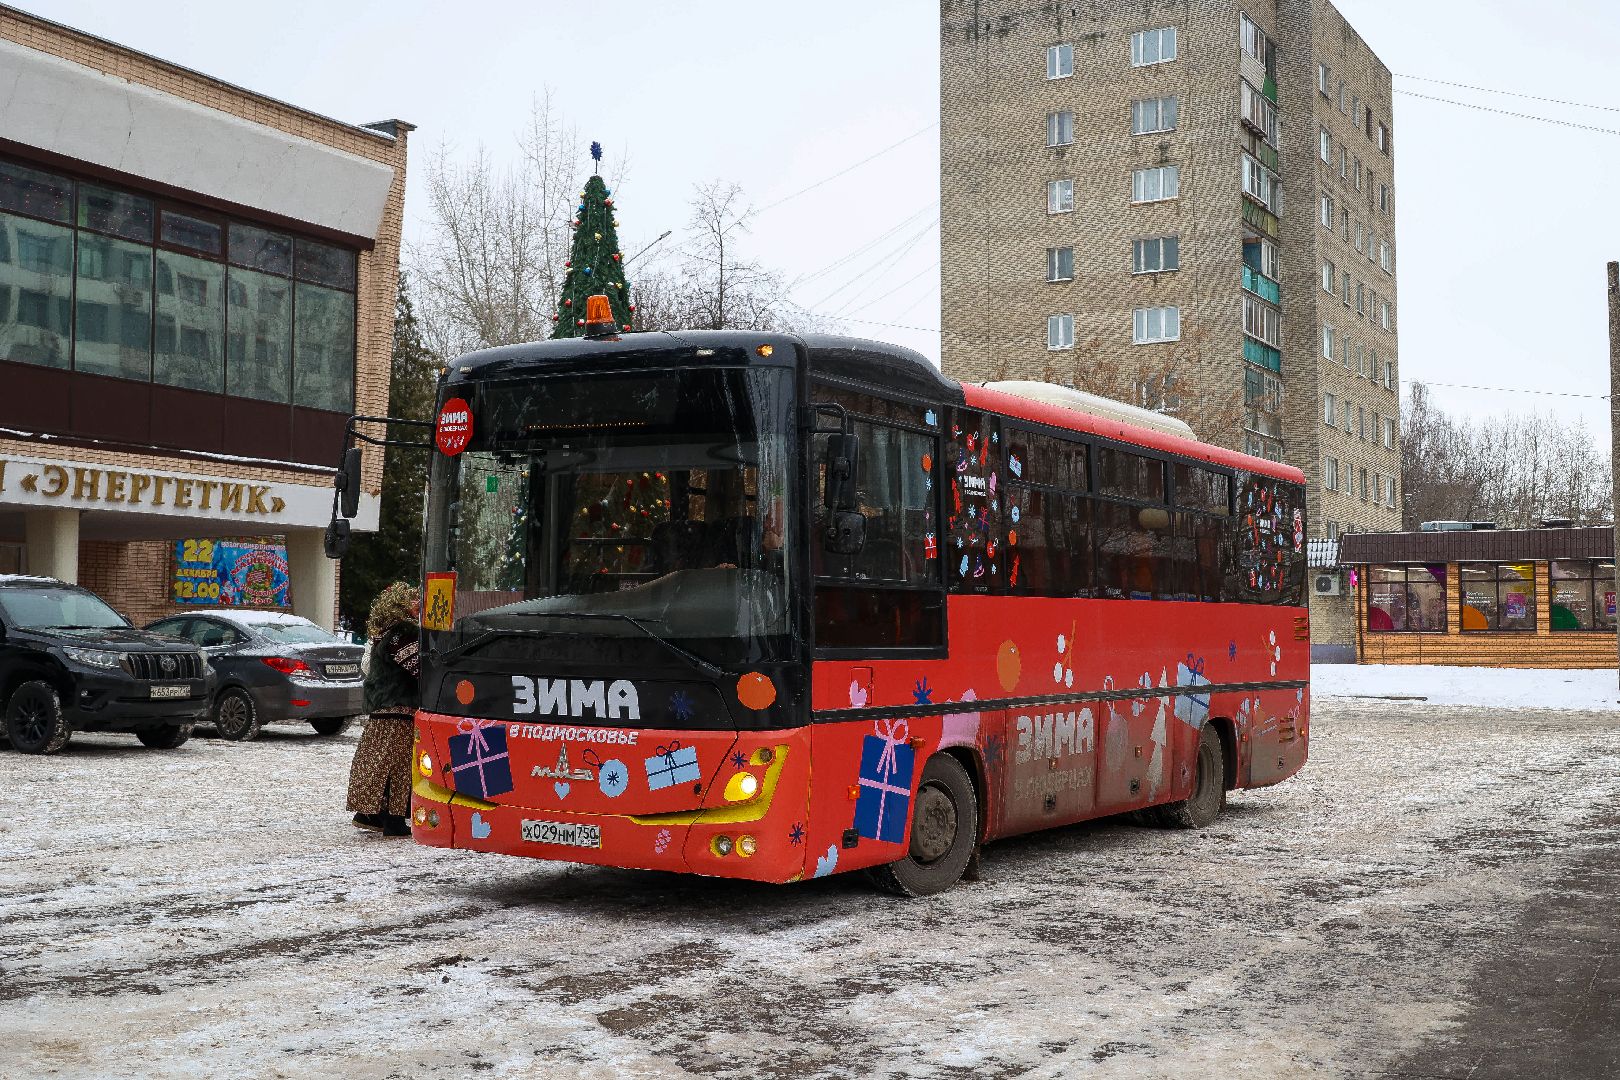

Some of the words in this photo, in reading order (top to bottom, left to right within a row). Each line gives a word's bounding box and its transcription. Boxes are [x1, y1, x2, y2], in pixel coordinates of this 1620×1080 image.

[441, 411, 468, 425] ЗИМА
[20, 464, 286, 515] «ЭНЕРГЕТИК»
[183, 539, 213, 563] 22
[176, 568, 218, 578] ДЕКАБРЯ
[173, 581, 220, 599] 12.00
[511, 675, 641, 720] ЗИМА
[509, 724, 520, 738] В
[521, 725, 640, 745] ПОДМОСКОВЬЕ
[1015, 707, 1095, 766] ЗИМА
[525, 824, 575, 843] Х029НМ
[577, 826, 596, 840] 750
